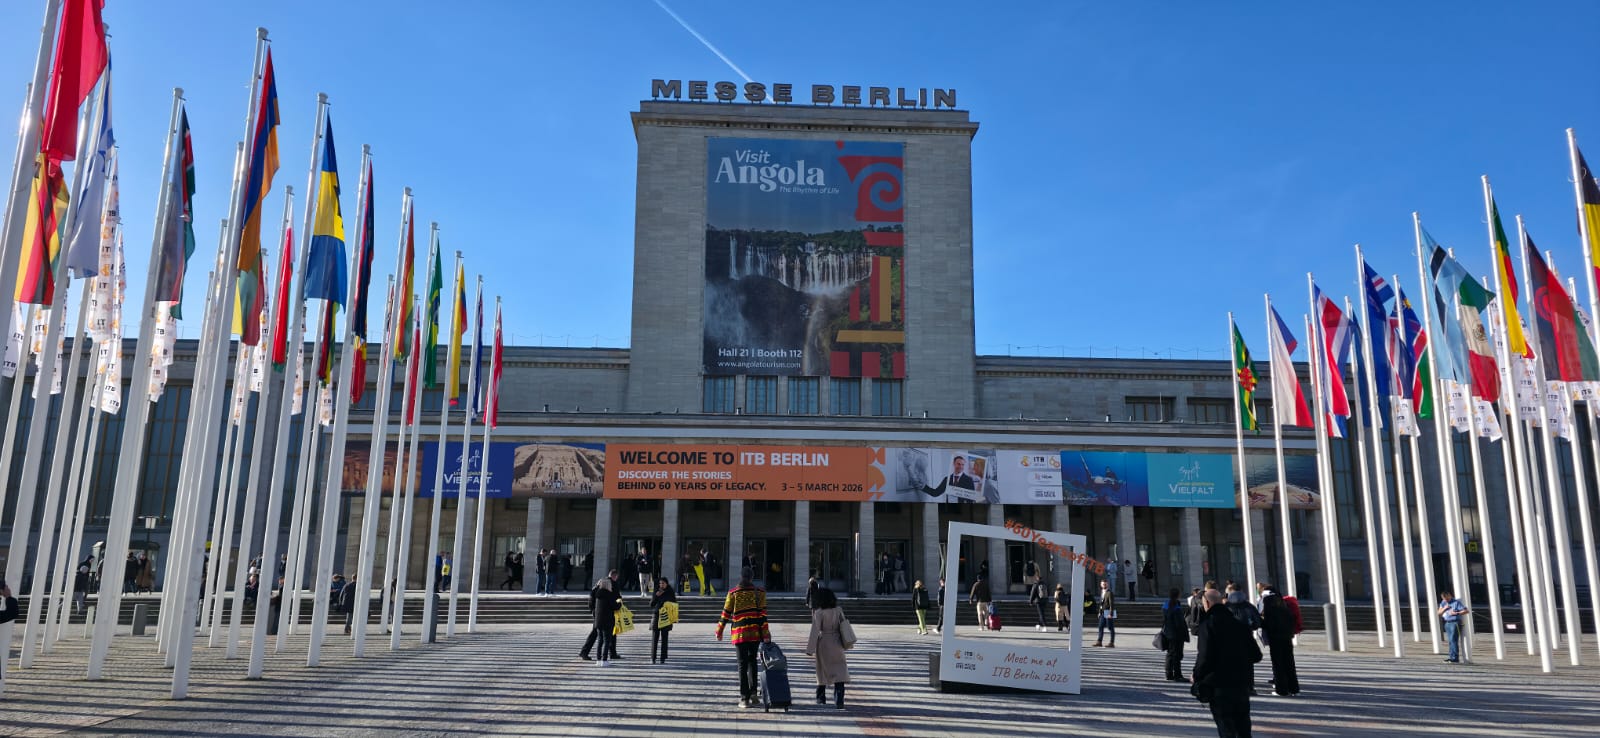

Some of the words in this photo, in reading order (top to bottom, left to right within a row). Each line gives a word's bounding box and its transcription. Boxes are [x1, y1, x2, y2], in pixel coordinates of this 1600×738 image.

[652, 79, 792, 103] MESSE
[812, 85, 955, 107] BERLIN
[735, 149, 771, 164] Visit
[714, 156, 825, 193] Angola
[779, 186, 792, 194] The
[792, 187, 818, 195] Rhythm
[818, 187, 827, 195] of
[827, 187, 840, 195] Life
[719, 348, 738, 357] Hall
[739, 348, 749, 357] 21
[757, 349, 787, 358] Booth
[789, 349, 803, 358] 112
[718, 361, 801, 369] www.angolatourism.com
[619, 451, 707, 466] WELCOME
[712, 451, 735, 465] TO
[740, 451, 766, 466] ITB
[770, 452, 829, 467] BERLIN
[618, 470, 668, 480] DISCOVER
[671, 471, 692, 480] THE
[692, 471, 732, 480] STORIES
[617, 481, 656, 491] BEHIND
[658, 482, 671, 491] 60
[674, 482, 707, 491] YEARS
[710, 482, 724, 491] OF
[725, 482, 767, 492] LEGACY.
[782, 483, 788, 492] 3
[797, 483, 803, 492] 5
[805, 483, 840, 492] MARCH
[842, 484, 863, 492] 2026
[1004, 519, 1105, 577] #60YearsofITB
[1003, 652, 1028, 664] Meet
[1030, 657, 1043, 665] me
[1046, 657, 1058, 668] at
[991, 666, 1012, 679] ITB
[1013, 668, 1040, 680] Berlin
[1044, 673, 1069, 683] 2026
